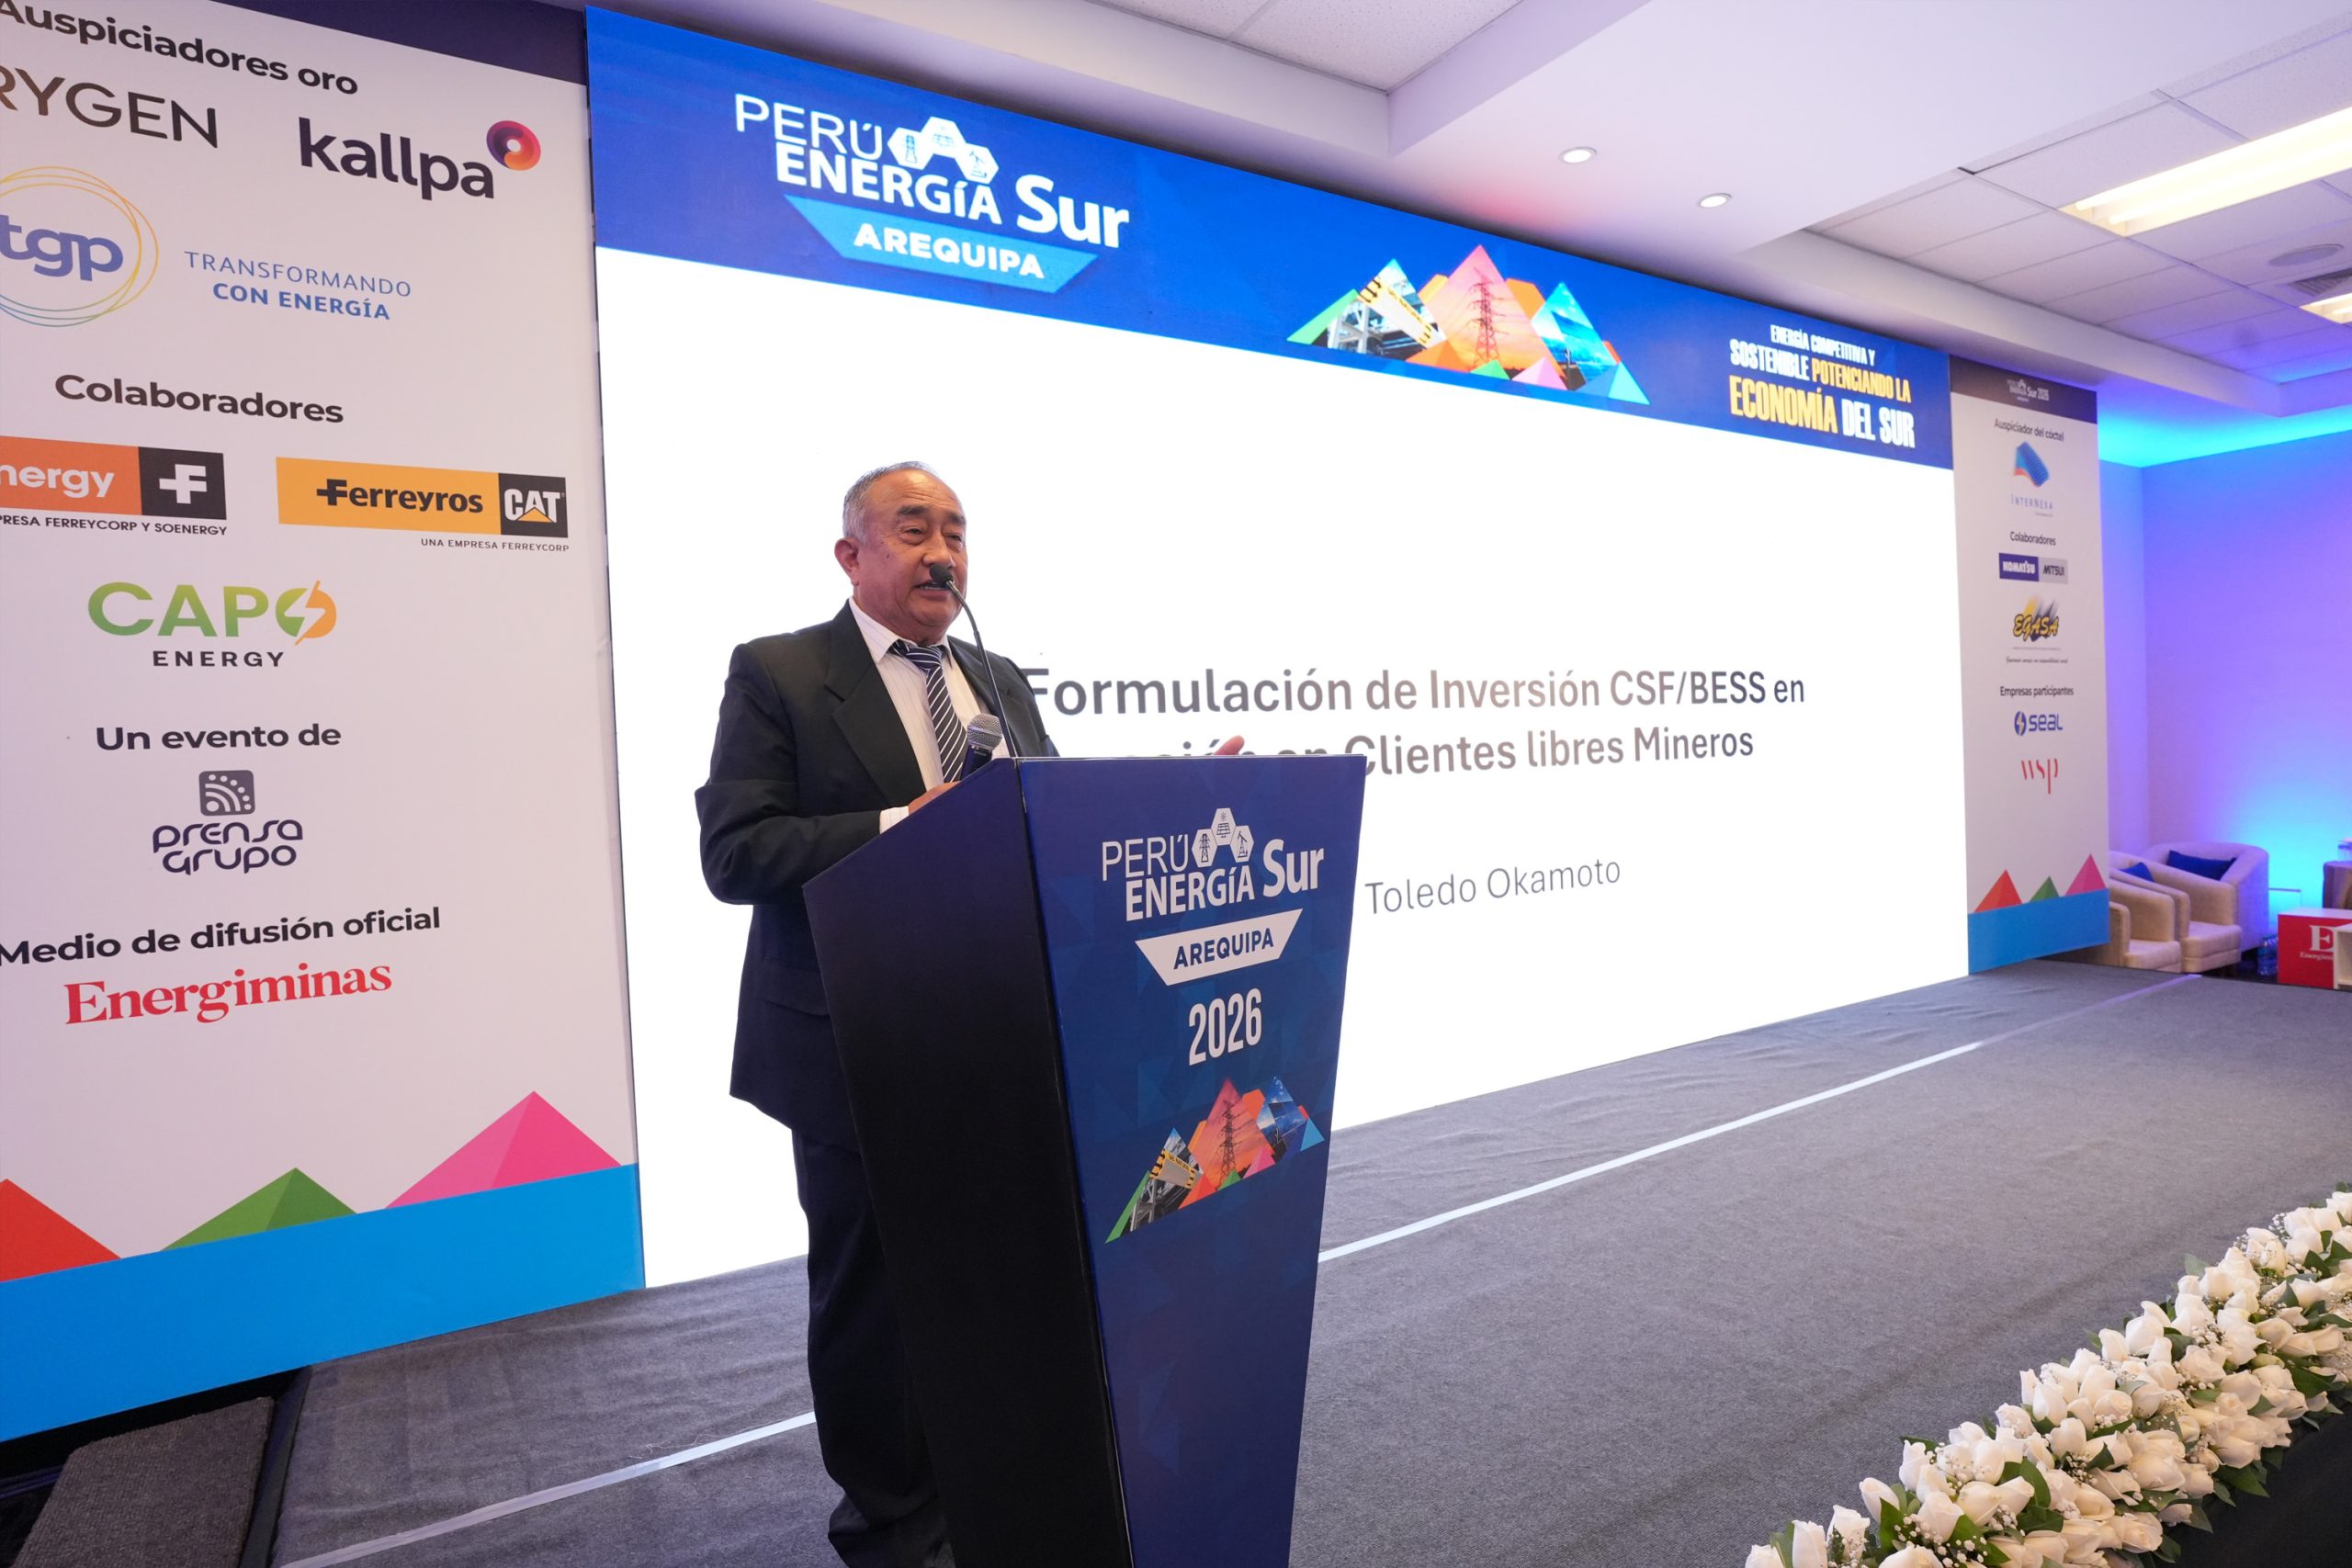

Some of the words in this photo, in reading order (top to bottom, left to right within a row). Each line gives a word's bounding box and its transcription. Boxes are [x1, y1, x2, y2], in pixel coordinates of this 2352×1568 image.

[0, 0, 288, 82] Auspiciadores
[298, 67, 358, 95] oro
[0, 65, 218, 149] RYGEN
[735, 93, 883, 162] PERÚ
[299, 117, 495, 200] kallpa
[775, 141, 1002, 225] ENERGÍA
[1014, 173, 1130, 249] Sur
[0, 214, 124, 281] tgp
[854, 222, 1046, 279] AREQUIPA
[184, 251, 412, 298] TRANSFORMANDO
[212, 283, 268, 305] CON
[278, 290, 390, 321] ENERGÍA
[1729, 338, 1810, 382] SOSTENIBLE
[1811, 357, 1894, 400] POTENCIANDO
[1895, 378, 1912, 404] LA
[1868, 348, 1876, 367] Y
[55, 374, 345, 423] Colaboradores
[1728, 375, 1838, 434] ECONOMÍA
[1841, 398, 1876, 441] DEL
[1878, 406, 1916, 448] SUR
[1994, 417, 2033, 434] Auspiciador
[2033, 425, 2044, 438] del
[2045, 427, 2065, 441] cóctel
[0, 514, 40, 526] RESA
[45, 517, 138, 533] FERREYCORP
[141, 523, 151, 533] Y
[154, 524, 228, 536] SOENERGY
[316, 478, 484, 513] Ferreyros
[504, 488, 560, 523] CAT
[421, 537, 444, 547] UNA
[448, 539, 498, 549] EMPRESA
[502, 542, 570, 552] FERREYCORP
[2009, 531, 2057, 547] Colaboradores
[2013, 613, 2060, 643] EGASA
[153, 650, 284, 668] ENERGY
[1366, 669, 1417, 711] de
[1430, 669, 1600, 709] Inversión
[1610, 670, 1766, 705] CSF/BESS
[1773, 679, 1805, 704] en
[2000, 686, 2032, 699] Empresas
[2033, 685, 2075, 698] participantes
[96, 727, 151, 750] Un
[161, 724, 288, 749] evento
[298, 723, 342, 746] de
[1344, 734, 1517, 777] Clientes
[1527, 728, 1624, 768] libres
[1634, 726, 1754, 761] Mineros
[1102, 833, 1189, 882] PERÚ
[1125, 864, 1256, 922] ENERGÍA
[1262, 839, 1325, 898] Sur
[1364, 874, 1477, 914] Toledo
[1487, 858, 1621, 898] Okamoto
[0, 933, 121, 966] Medio
[131, 930, 181, 954] de
[190, 917, 334, 950] difusión
[343, 907, 441, 936] oficial
[1173, 927, 1275, 970] AREQUIPA
[63, 962, 392, 1025] Energiminas
[1188, 987, 1263, 1066] 2026
